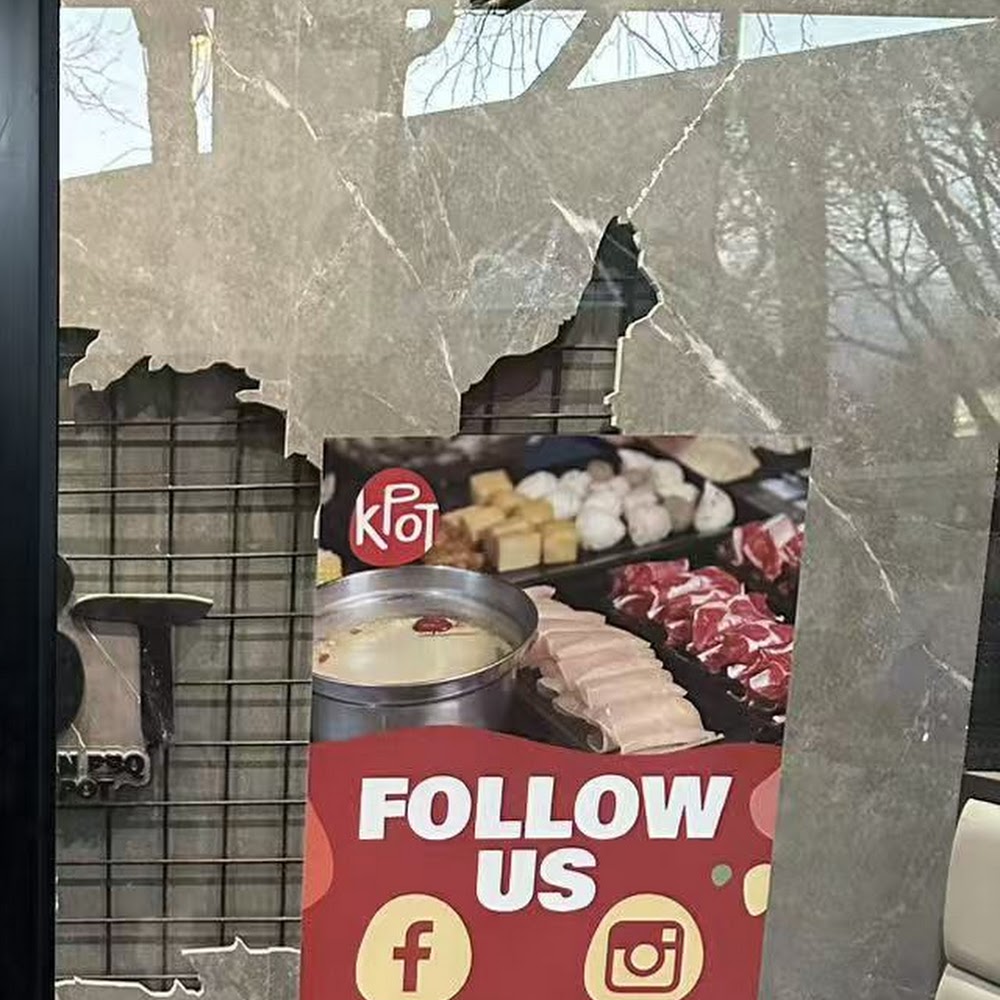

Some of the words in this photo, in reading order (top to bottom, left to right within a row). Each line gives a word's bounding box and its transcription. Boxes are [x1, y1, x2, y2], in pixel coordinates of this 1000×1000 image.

[354, 482, 440, 550] KPOT
[358, 774, 733, 841] FOLLOW
[475, 847, 597, 912] US
